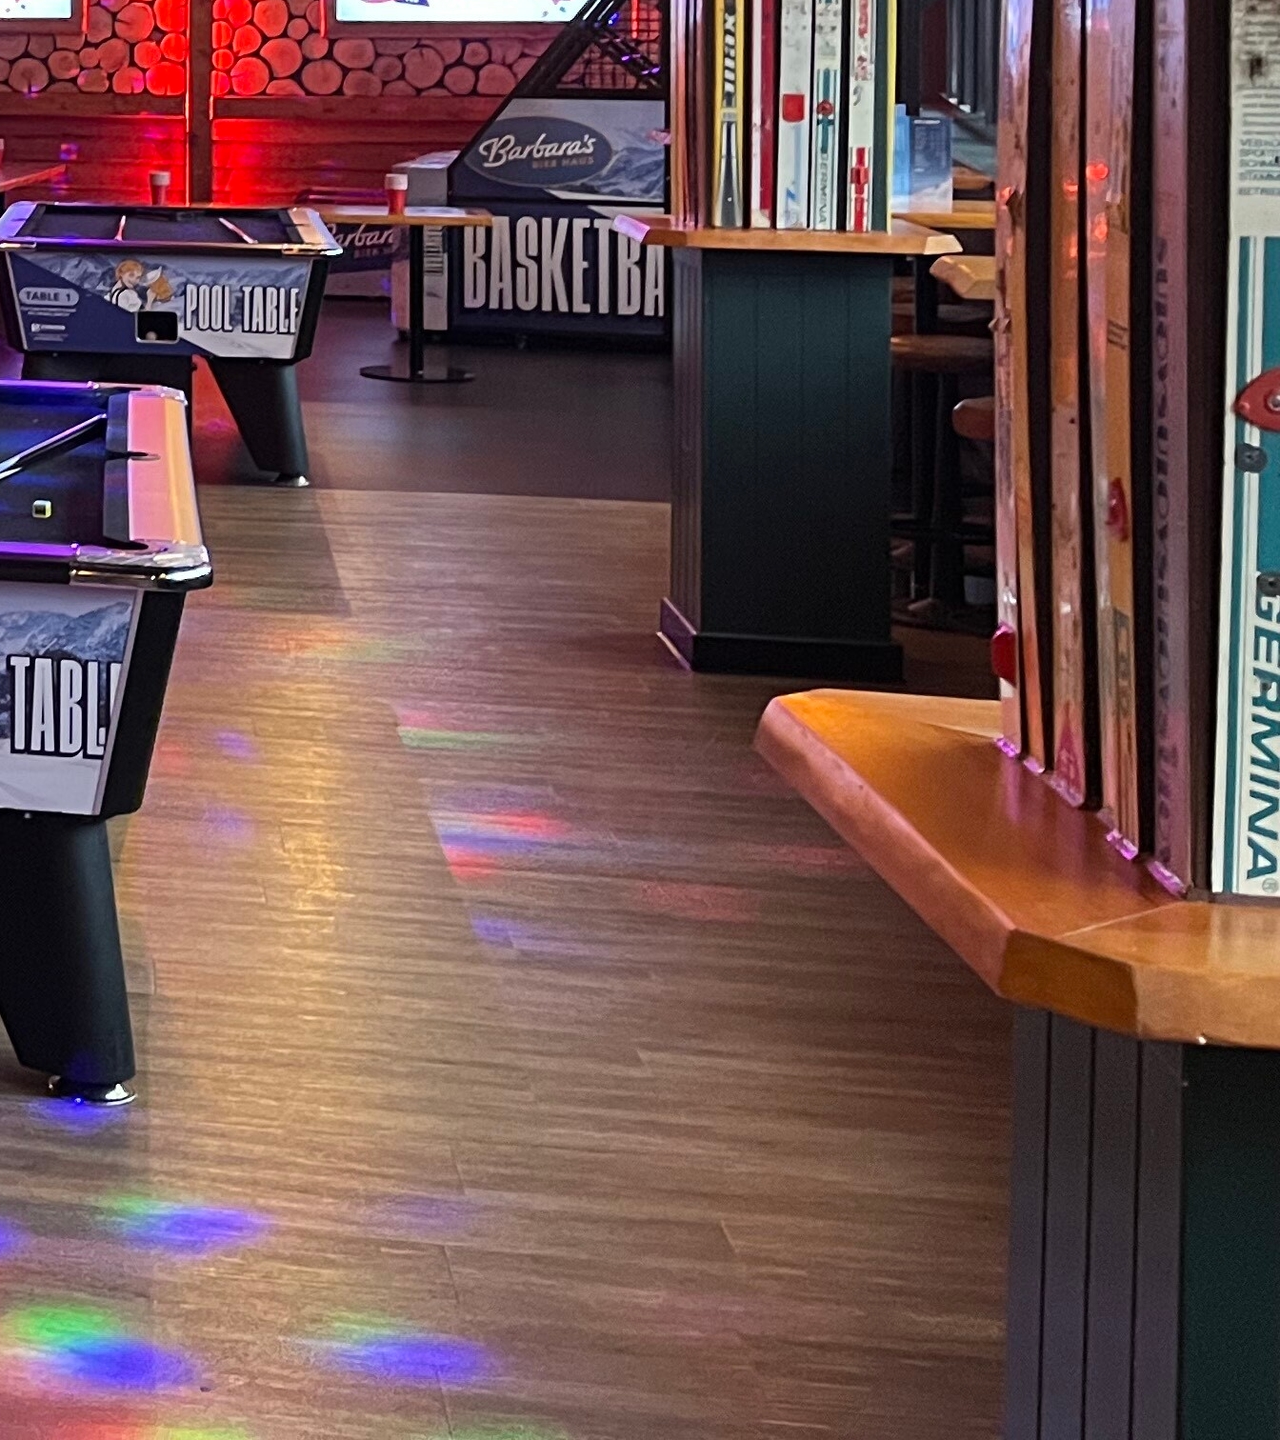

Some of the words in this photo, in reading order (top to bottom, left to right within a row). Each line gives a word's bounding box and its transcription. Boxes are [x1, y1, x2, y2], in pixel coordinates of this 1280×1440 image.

[478, 132, 596, 168] Barbara's
[25, 290, 61, 303] TABLE
[65, 291, 72, 302] 1
[184, 283, 234, 332] POOL
[241, 285, 300, 334] TABLE
[1246, 593, 1280, 881] GERMINA
